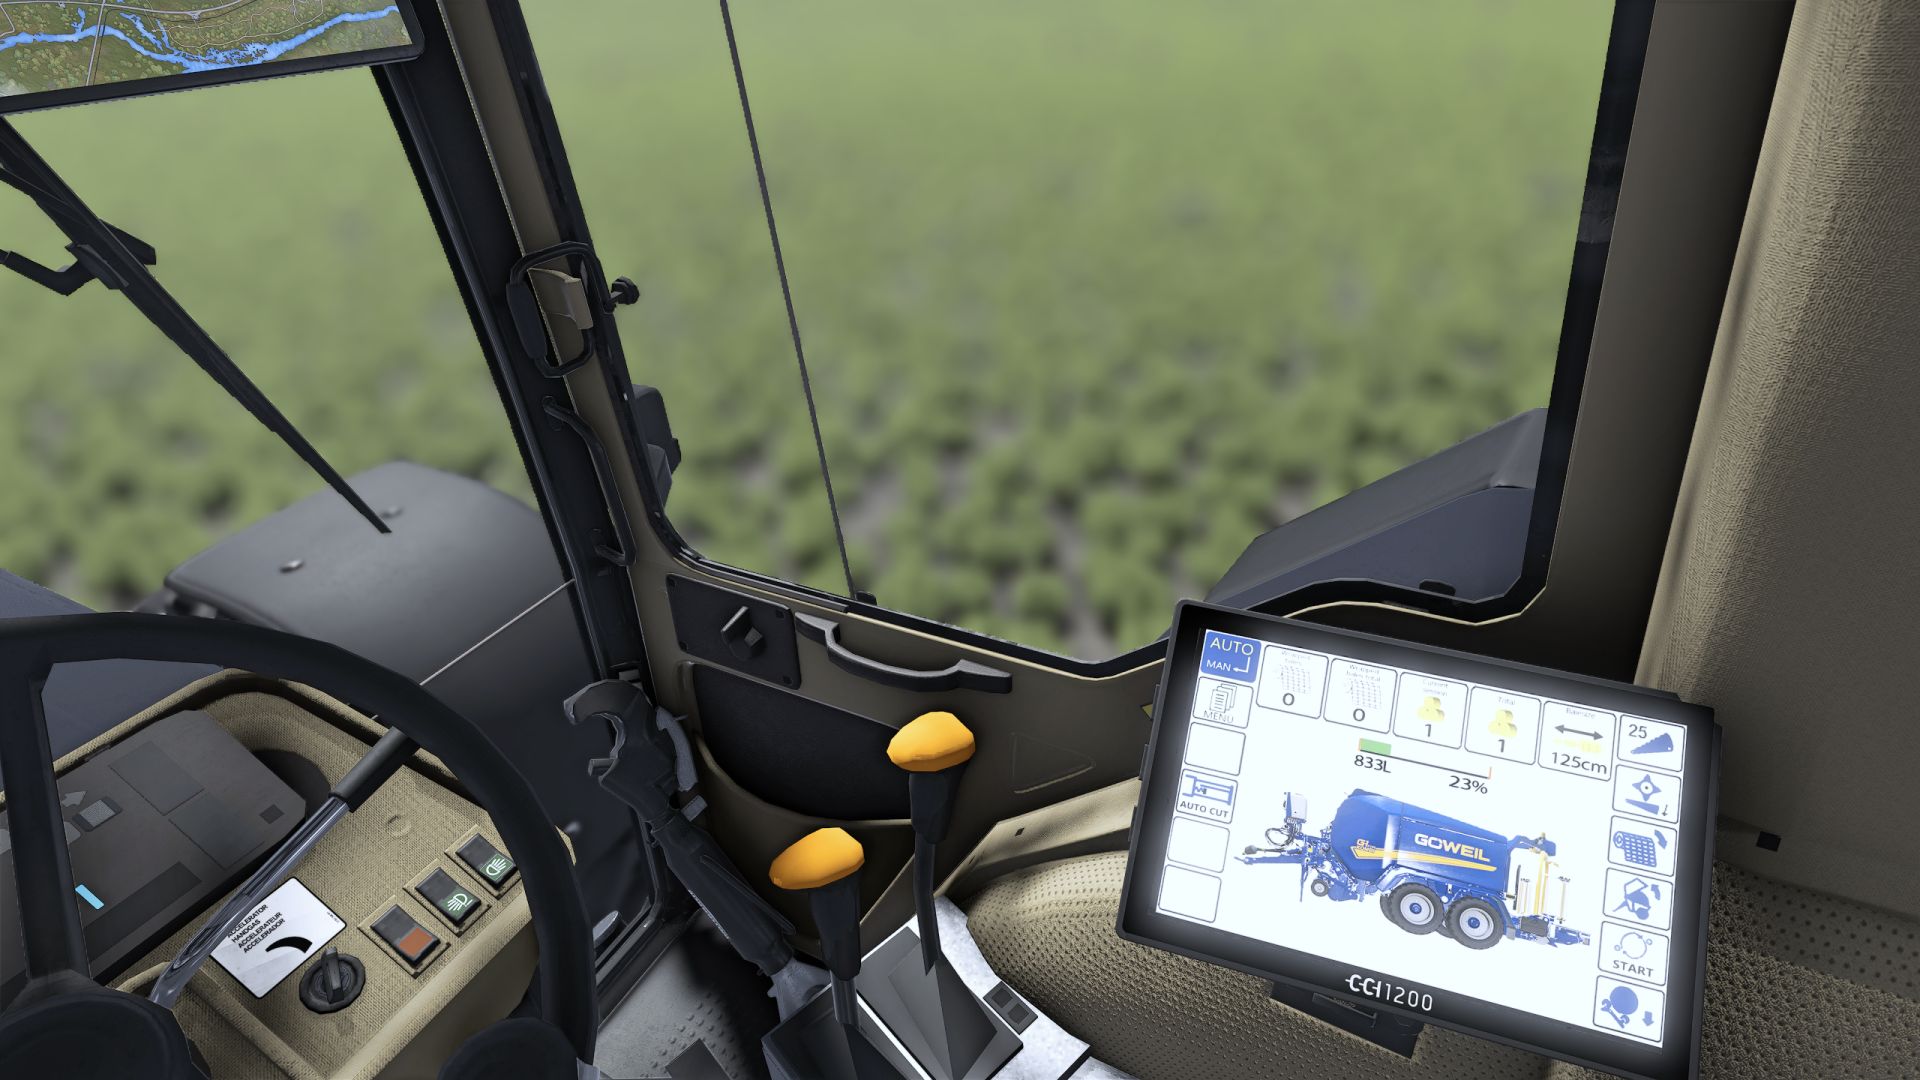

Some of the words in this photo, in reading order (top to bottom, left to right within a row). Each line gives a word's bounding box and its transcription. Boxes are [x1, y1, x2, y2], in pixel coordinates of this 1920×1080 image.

[1210, 637, 1254, 656] AUTO
[1206, 659, 1232, 672] MAN
[1203, 710, 1234, 724] MENU
[1424, 723, 1432, 737] 1
[1628, 723, 1648, 739] 25
[1498, 739, 1506, 753] 1
[1354, 754, 1392, 774] 833L
[1552, 751, 1608, 775] 125cm
[1448, 775, 1488, 794] 23%
[1180, 800, 1207, 813] AUTO
[1209, 807, 1230, 818] CUT
[227, 903, 269, 939] ACCELERATOR
[238, 911, 283, 949] ACCELERATEUR
[231, 918, 262, 944] HANDGAS
[243, 918, 286, 954] ACCELERADOR
[1612, 959, 1654, 978] START
